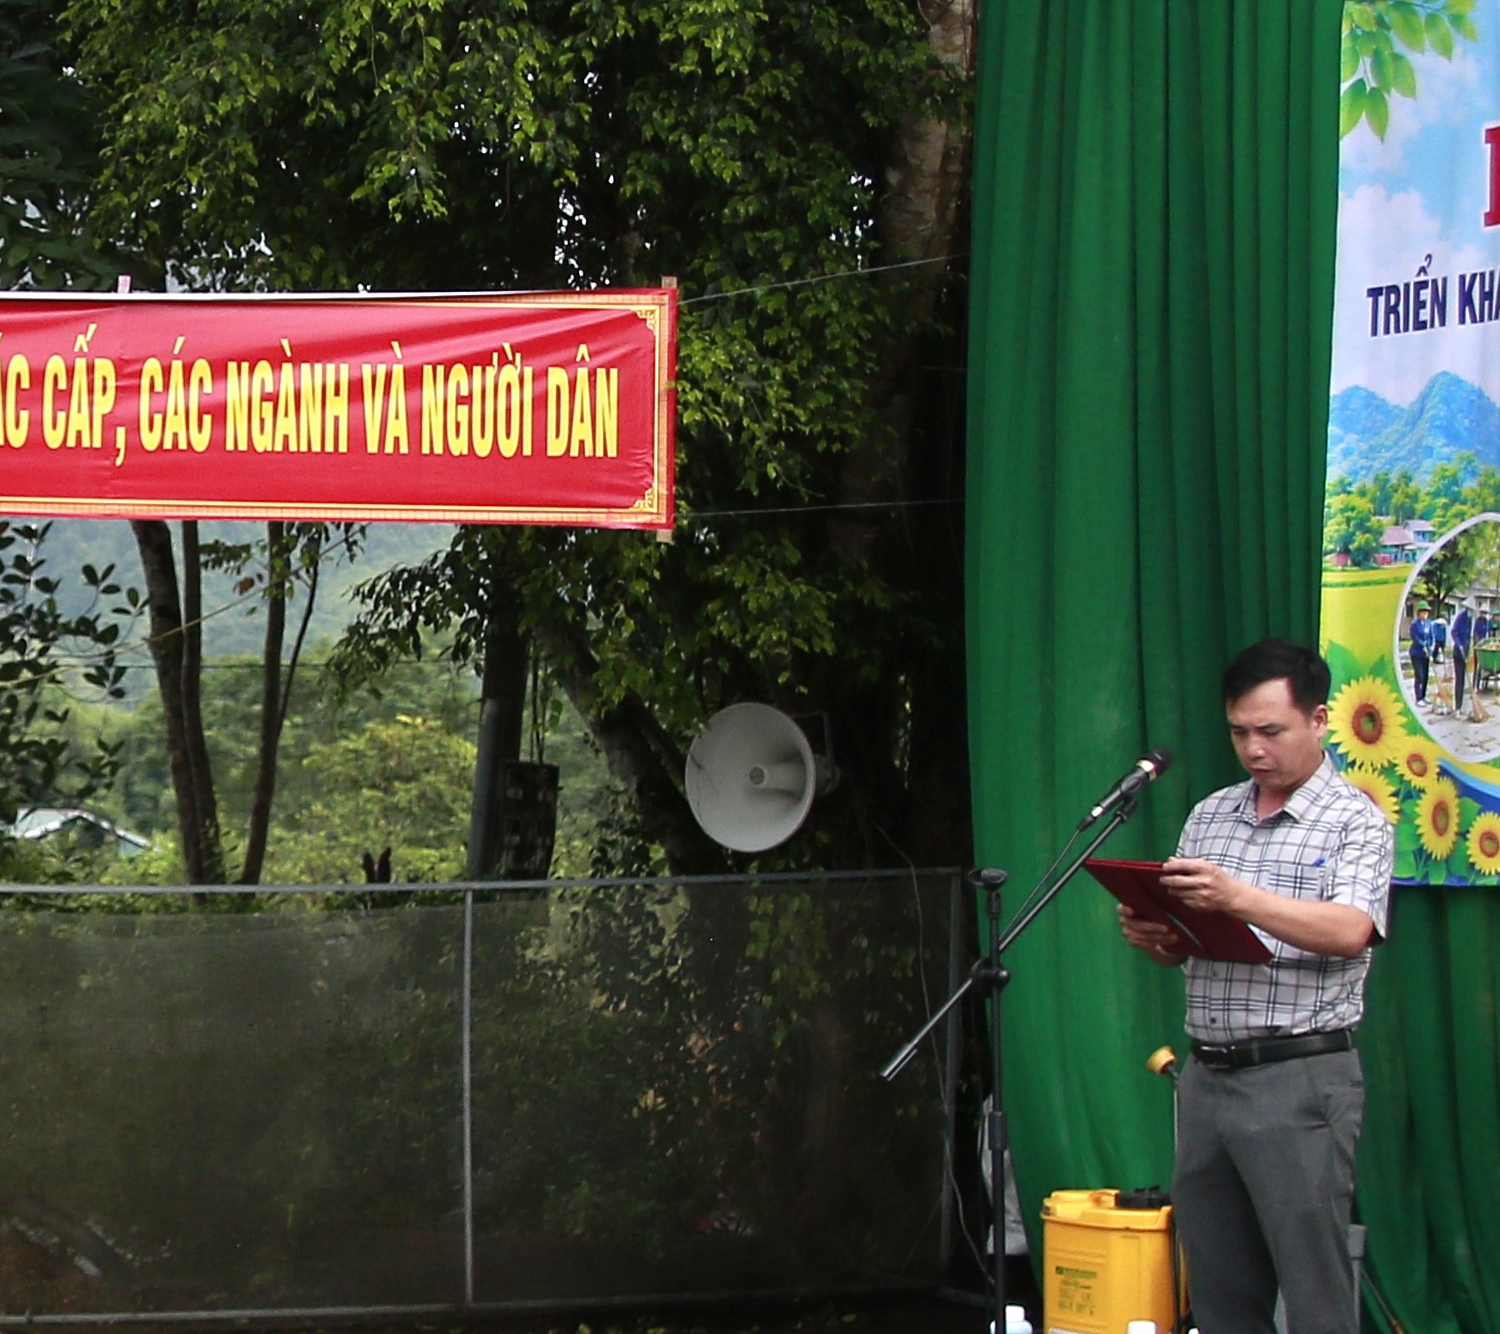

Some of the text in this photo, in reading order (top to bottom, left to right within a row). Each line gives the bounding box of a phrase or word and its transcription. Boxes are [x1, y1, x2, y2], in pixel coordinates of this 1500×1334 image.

[1367, 254, 1447, 336] TRIỂN
[43, 325, 126, 465] CẤP,
[139, 338, 213, 452] CÁC
[226, 340, 350, 452] NGÀNH
[362, 342, 409, 453] VÀ
[422, 343, 533, 457] NGƯỜI
[547, 345, 618, 457] DÂN
